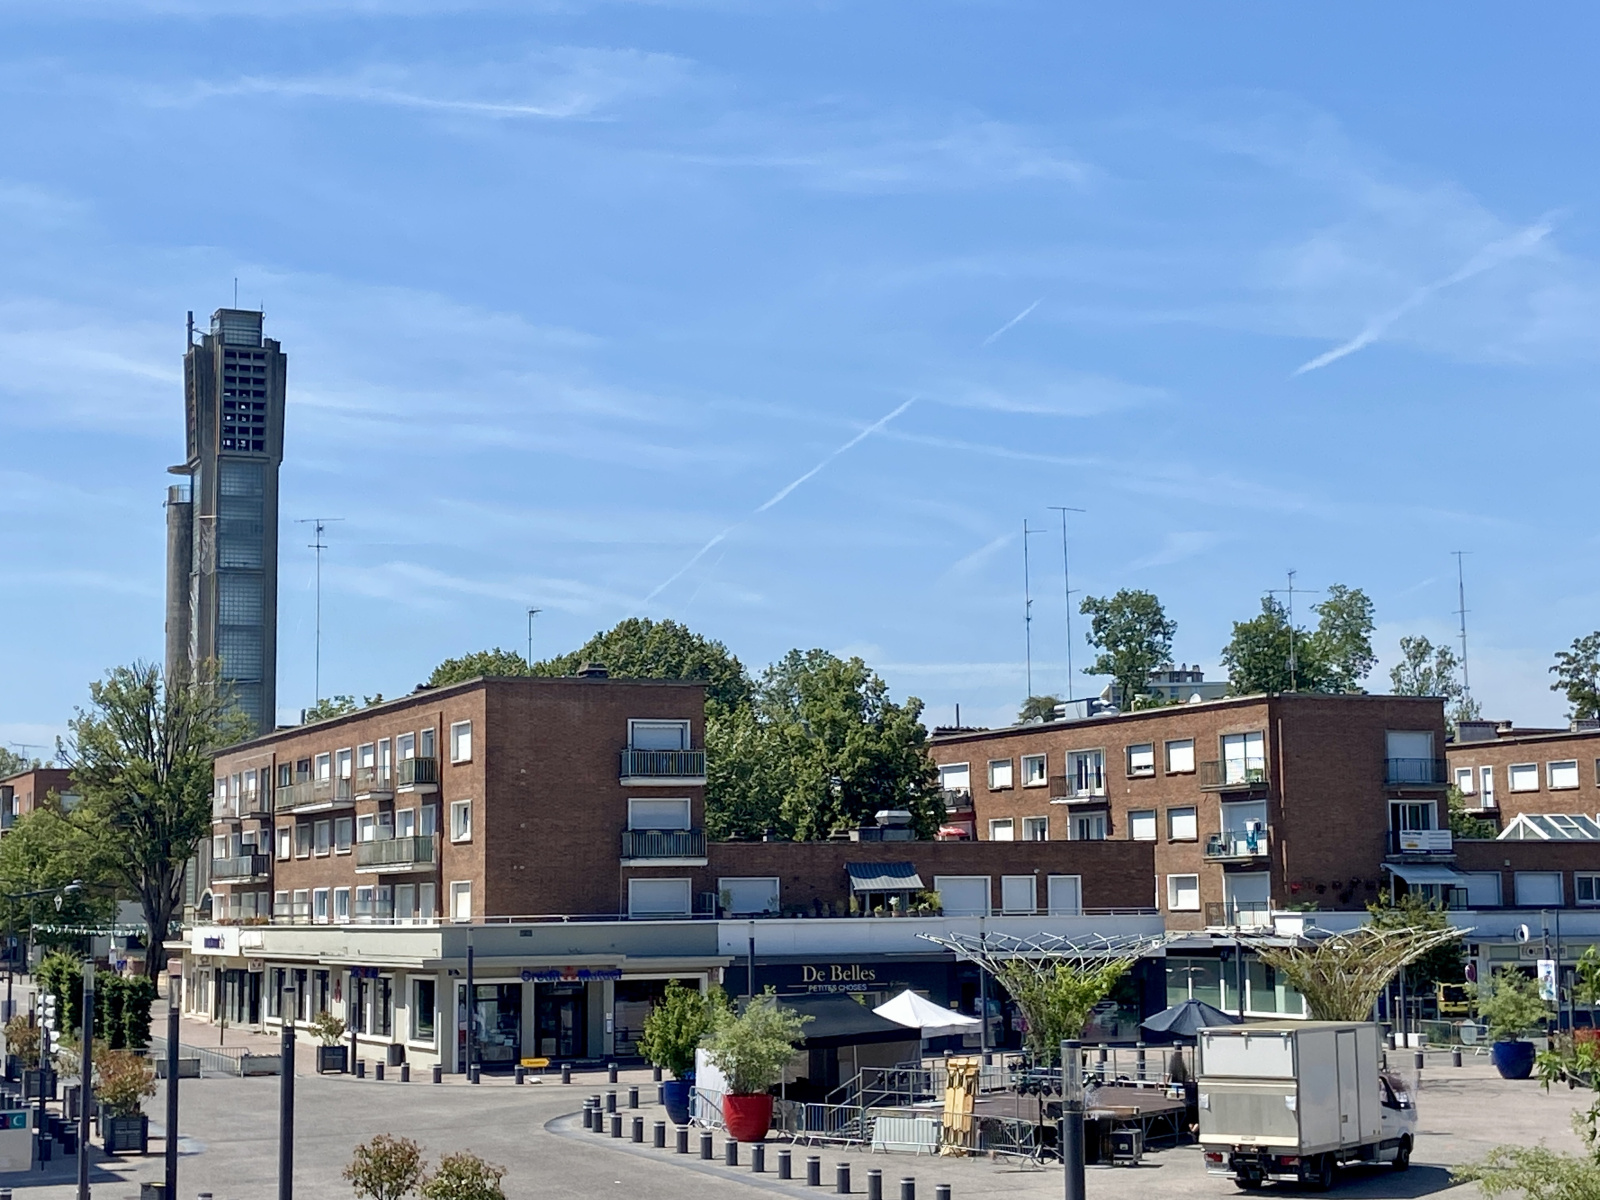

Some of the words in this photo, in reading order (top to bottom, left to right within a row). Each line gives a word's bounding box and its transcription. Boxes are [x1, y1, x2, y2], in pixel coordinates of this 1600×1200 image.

[802, 965, 826, 982] De
[830, 964, 876, 981] Belles
[808, 984, 837, 993] PETITES
[838, 983, 868, 992] CHOSES
